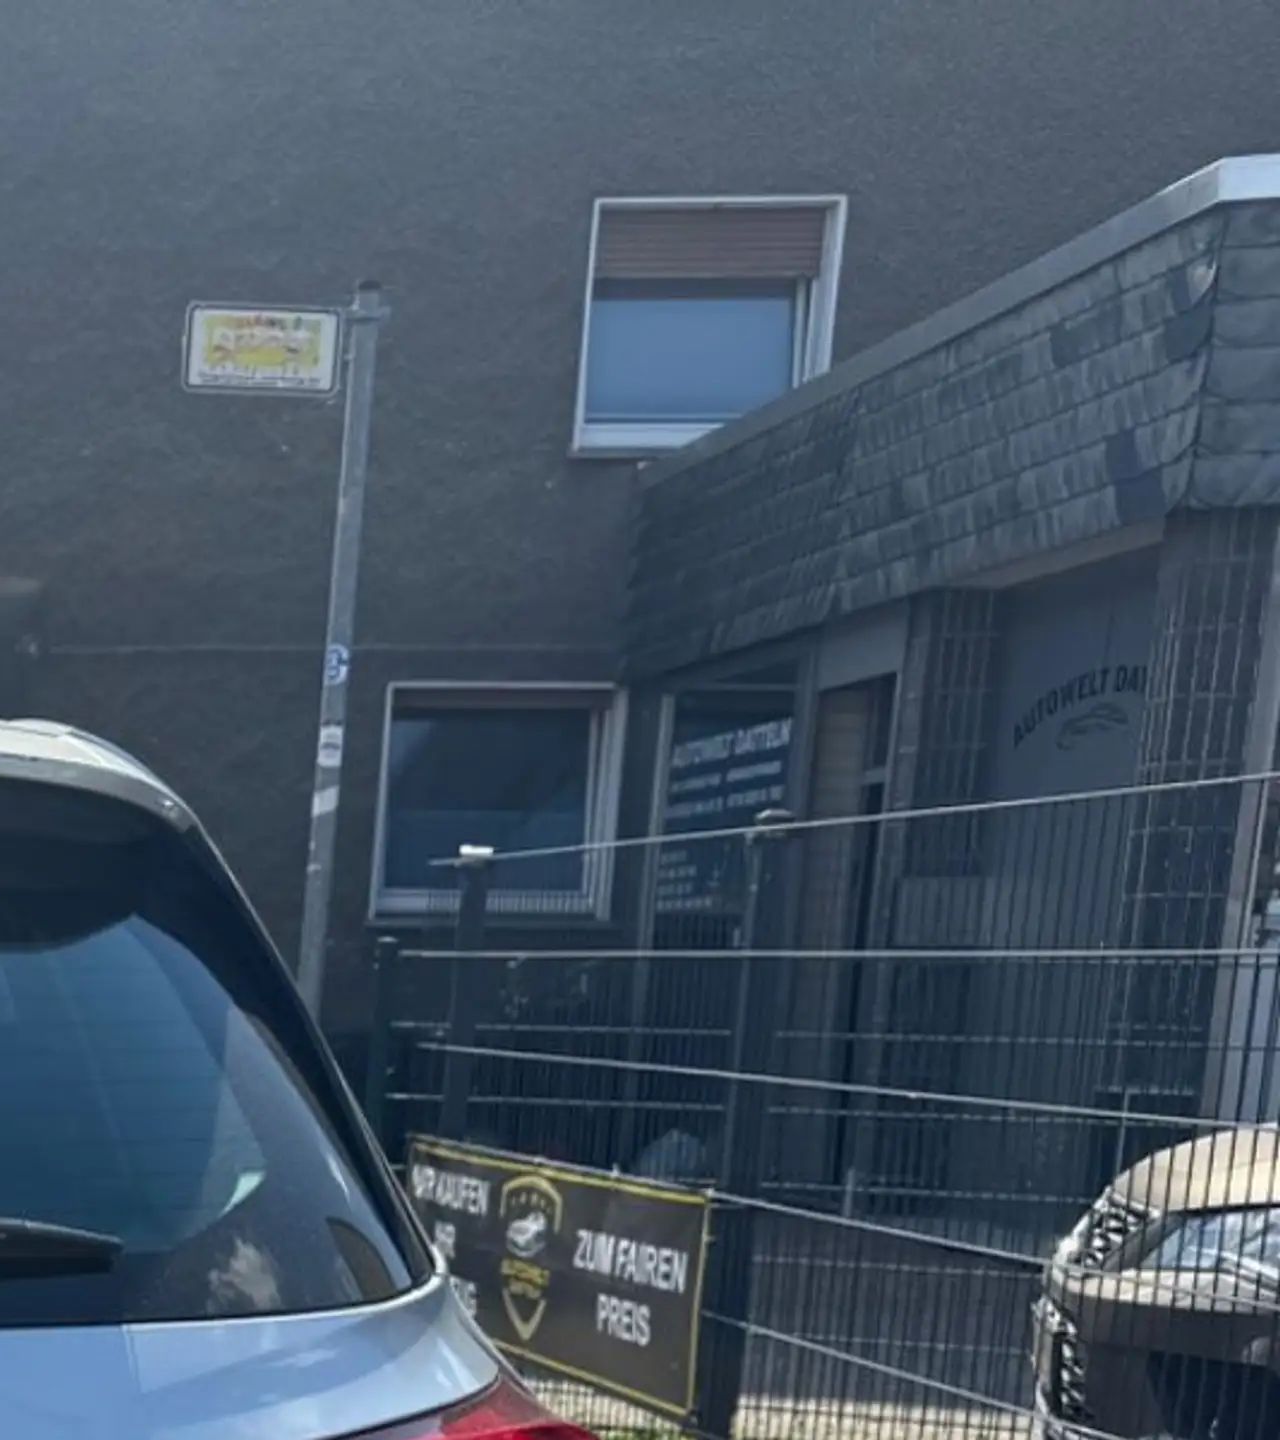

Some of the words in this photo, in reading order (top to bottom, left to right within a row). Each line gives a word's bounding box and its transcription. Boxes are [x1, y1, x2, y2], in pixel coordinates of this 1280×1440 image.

[1013, 667, 1110, 750] AUTOWELT
[435, 1171, 490, 1217] KAUFEN
[572, 1229, 617, 1277] ZUM
[614, 1237, 689, 1295] FAIREN
[596, 1292, 652, 1347] PREIS
